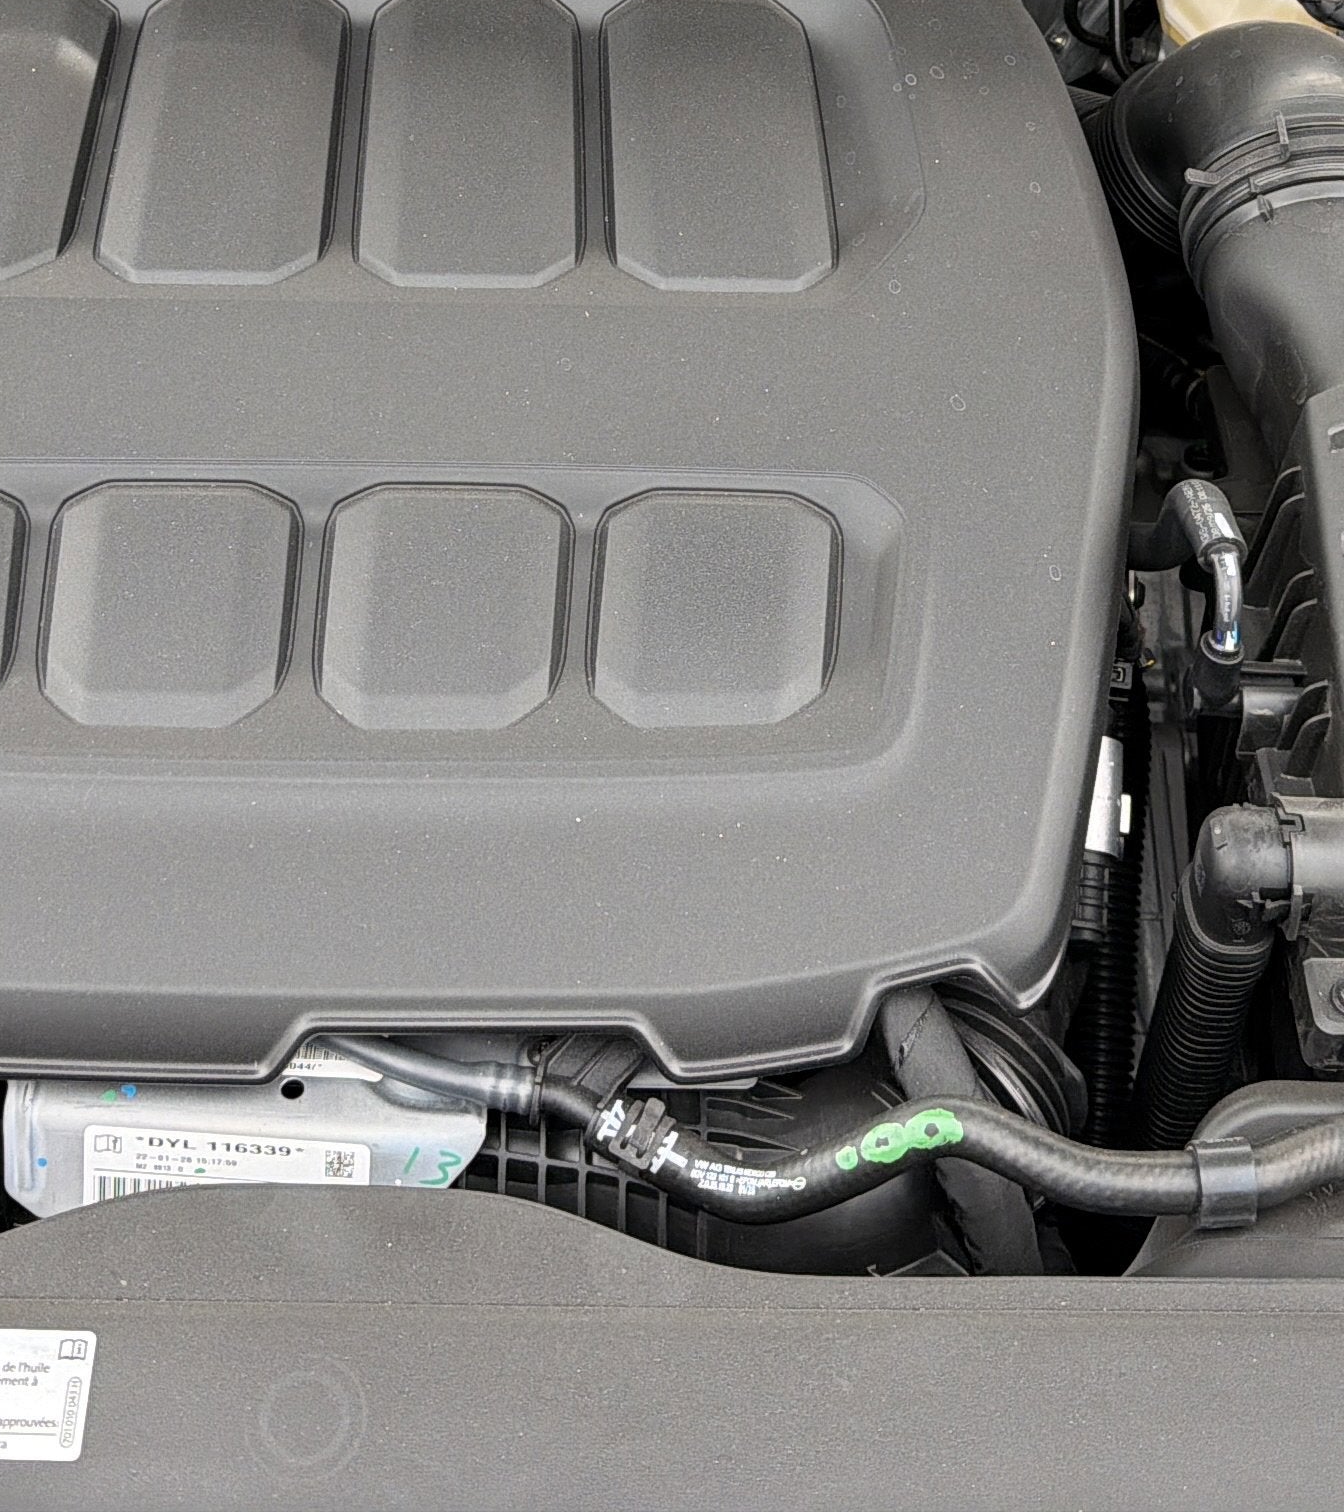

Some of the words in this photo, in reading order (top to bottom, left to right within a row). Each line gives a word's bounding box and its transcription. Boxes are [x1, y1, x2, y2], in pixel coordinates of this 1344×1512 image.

[2, 1362, 17, 1373] de
[18, 1362, 51, 1373] l'huile
[31, 1375, 39, 1386] à
